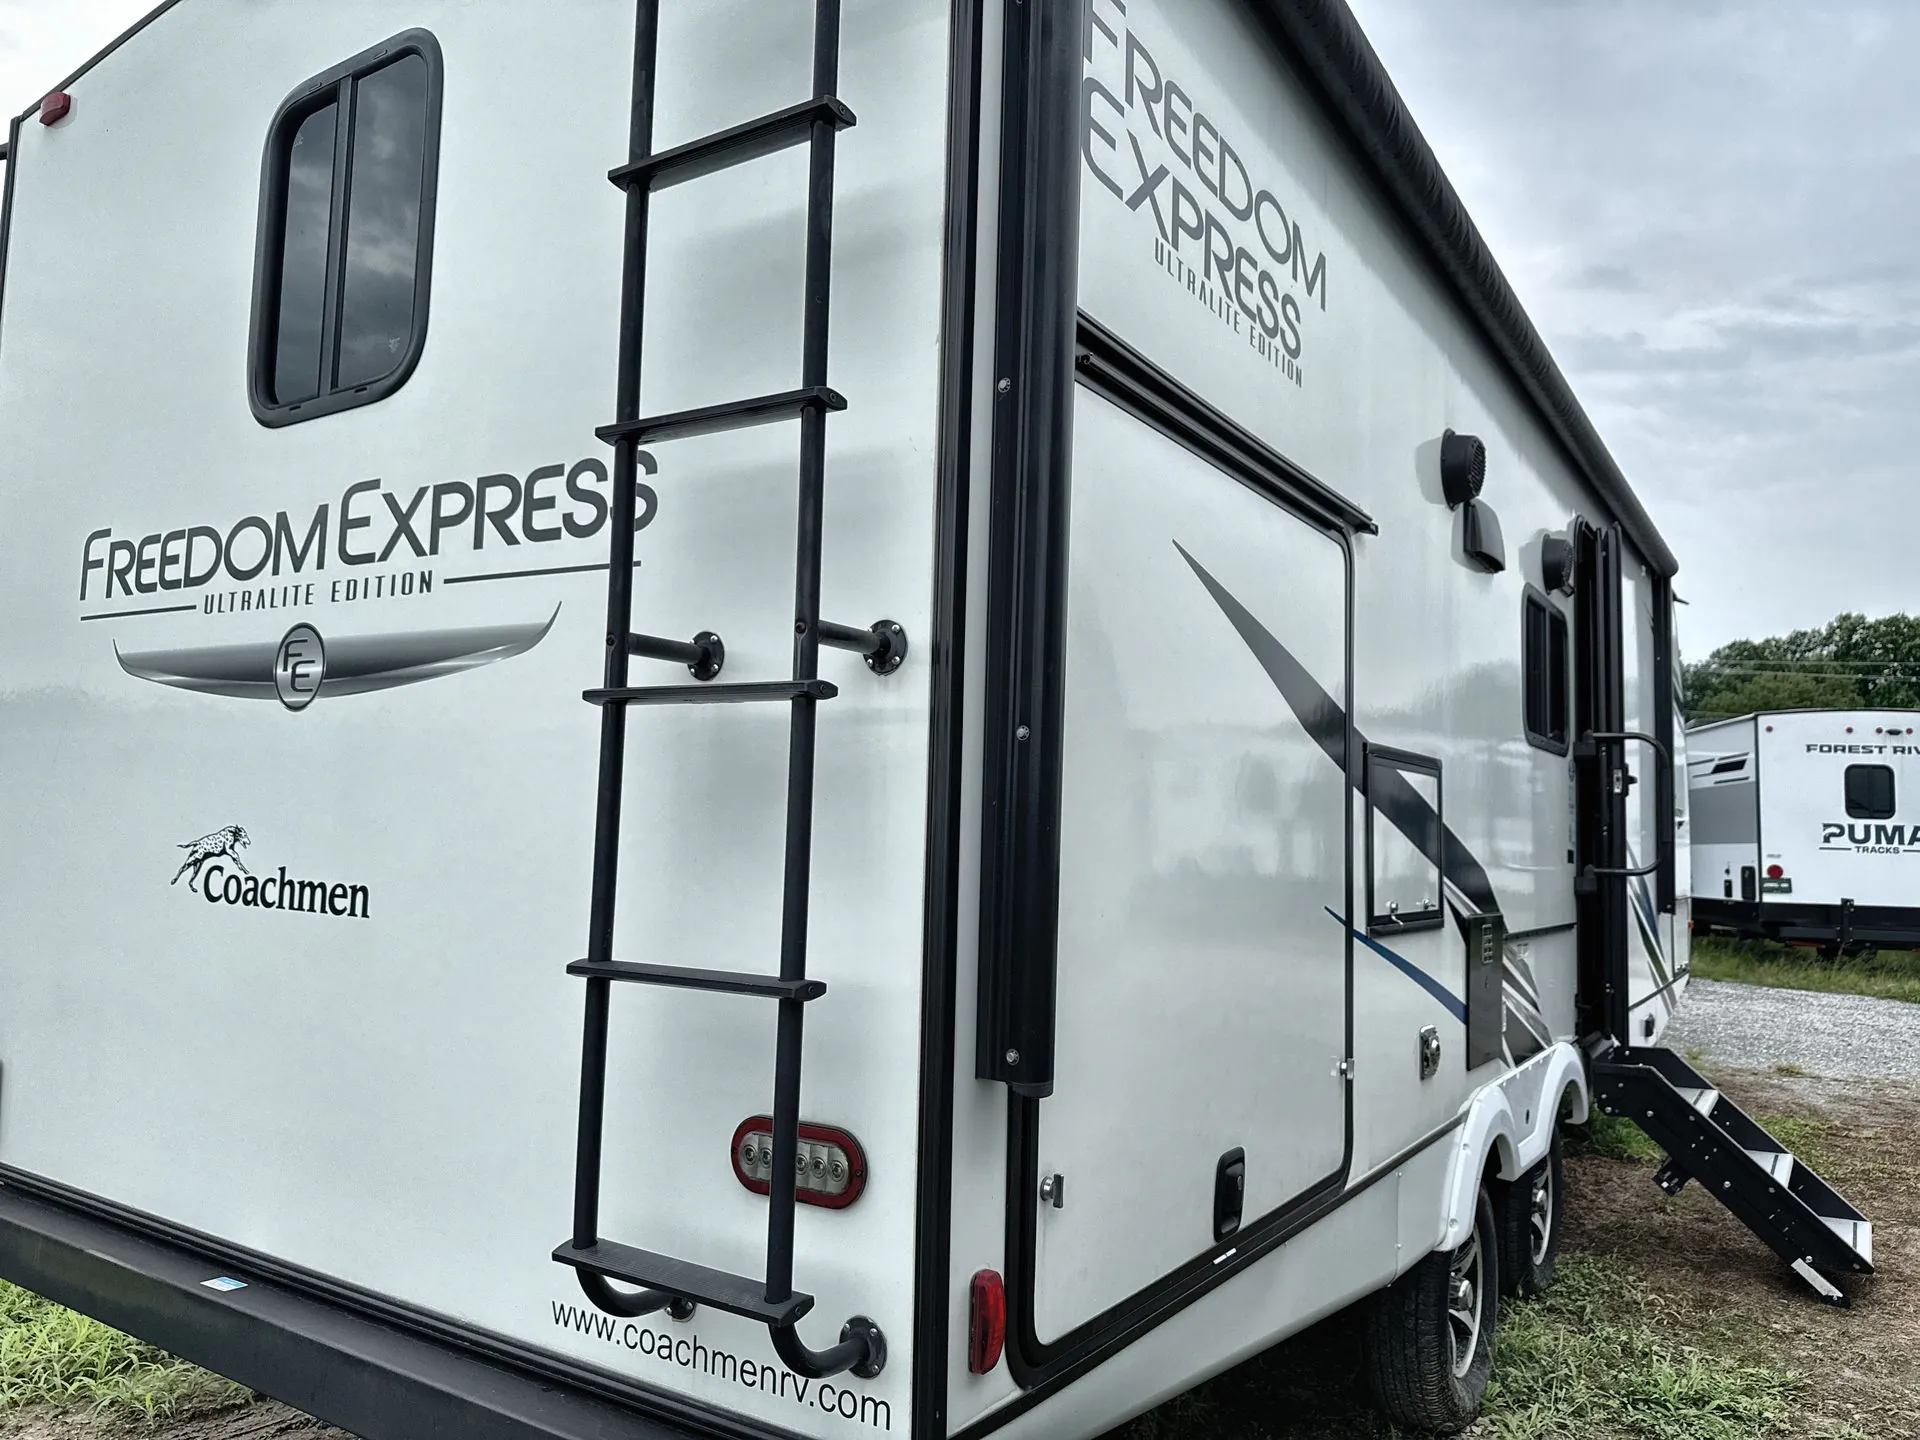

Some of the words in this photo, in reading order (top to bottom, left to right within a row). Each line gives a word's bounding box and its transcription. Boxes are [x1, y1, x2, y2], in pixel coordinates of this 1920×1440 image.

[1084, 0, 1326, 312] FREEDOM
[1083, 76, 1301, 360] EXPRESS
[1154, 237, 1241, 335] ULTRALITE
[1249, 325, 1302, 388] EDITION
[80, 503, 330, 601] FREEDOM
[203, 583, 315, 615] ULTRALITE
[331, 570, 434, 603] EDITION
[1805, 743, 1888, 755] FOREST
[203, 865, 370, 919] Coachmen
[1854, 845, 1901, 855] TRACKS
[552, 1300, 892, 1431] www.coachmenrv.com
